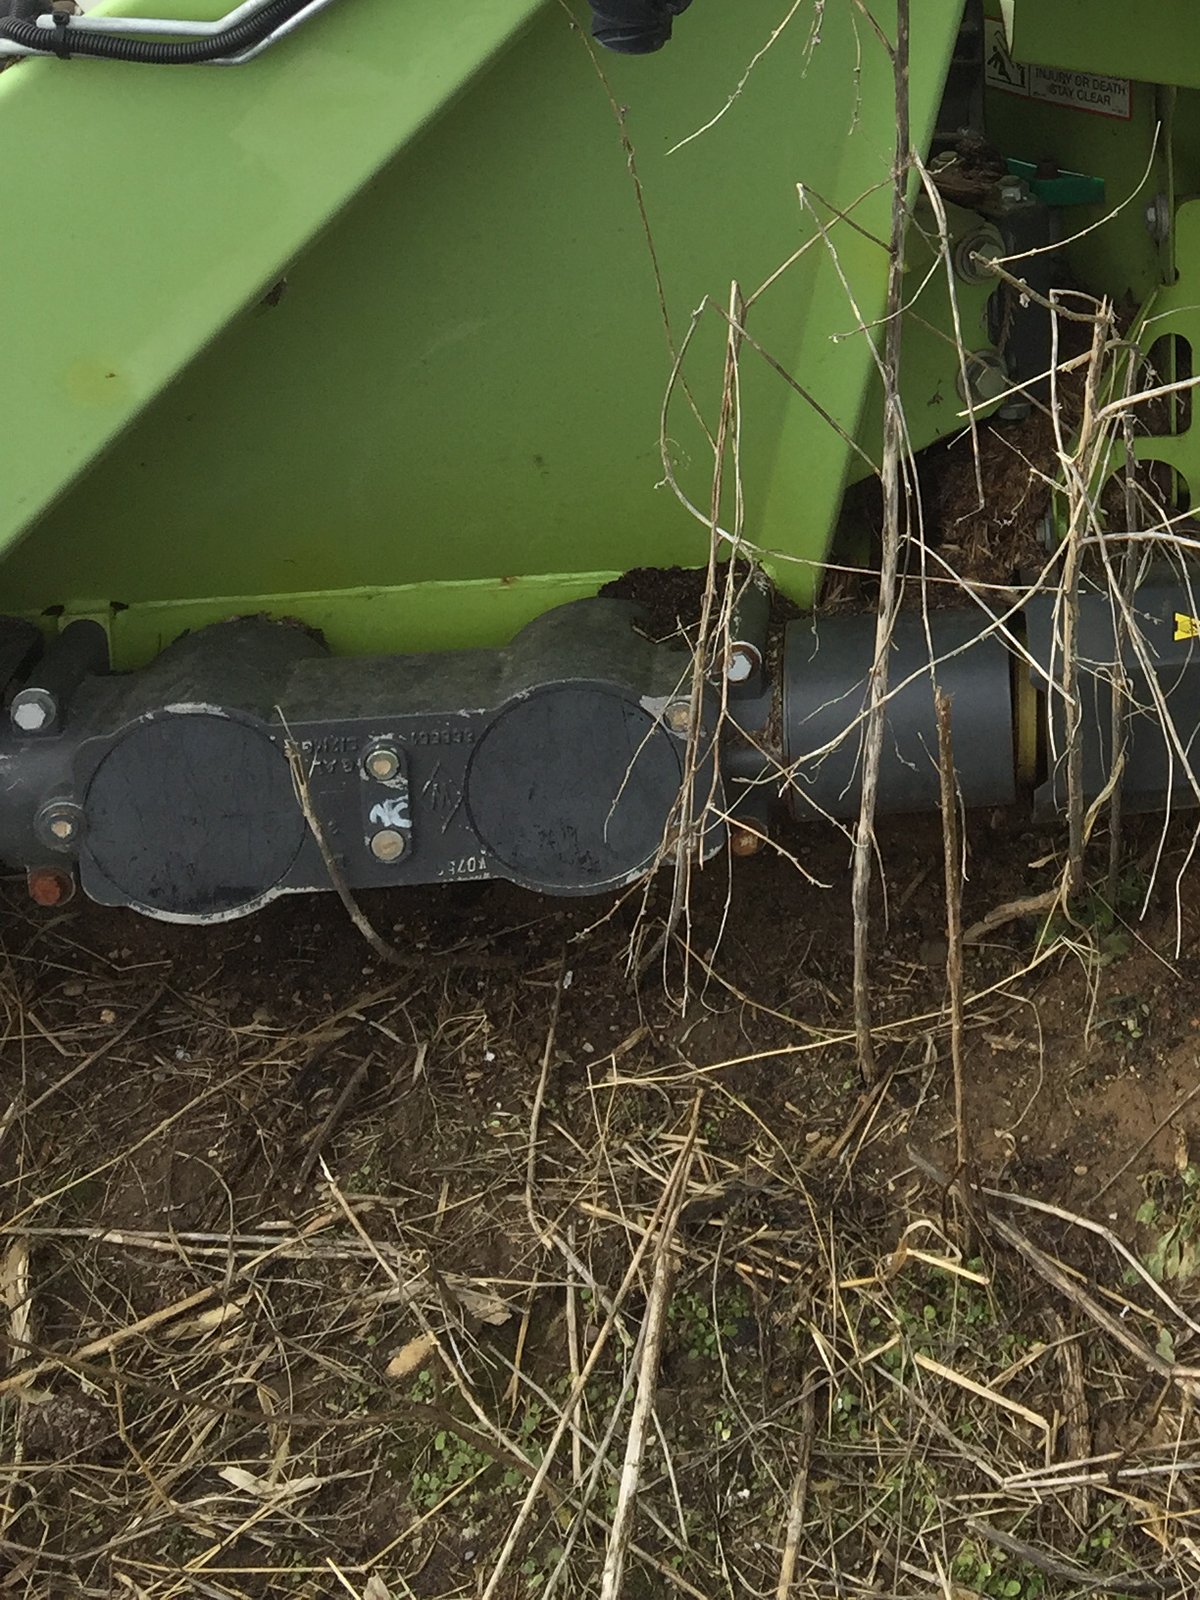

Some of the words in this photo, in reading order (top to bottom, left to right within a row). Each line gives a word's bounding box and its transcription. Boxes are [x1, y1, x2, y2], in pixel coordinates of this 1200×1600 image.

[1035, 68, 1073, 84] INJURY
[1074, 75, 1090, 88] OR
[1092, 80, 1126, 95] DEATH
[1048, 82, 1074, 97] STAY
[1076, 90, 1112, 106] CLEAR
